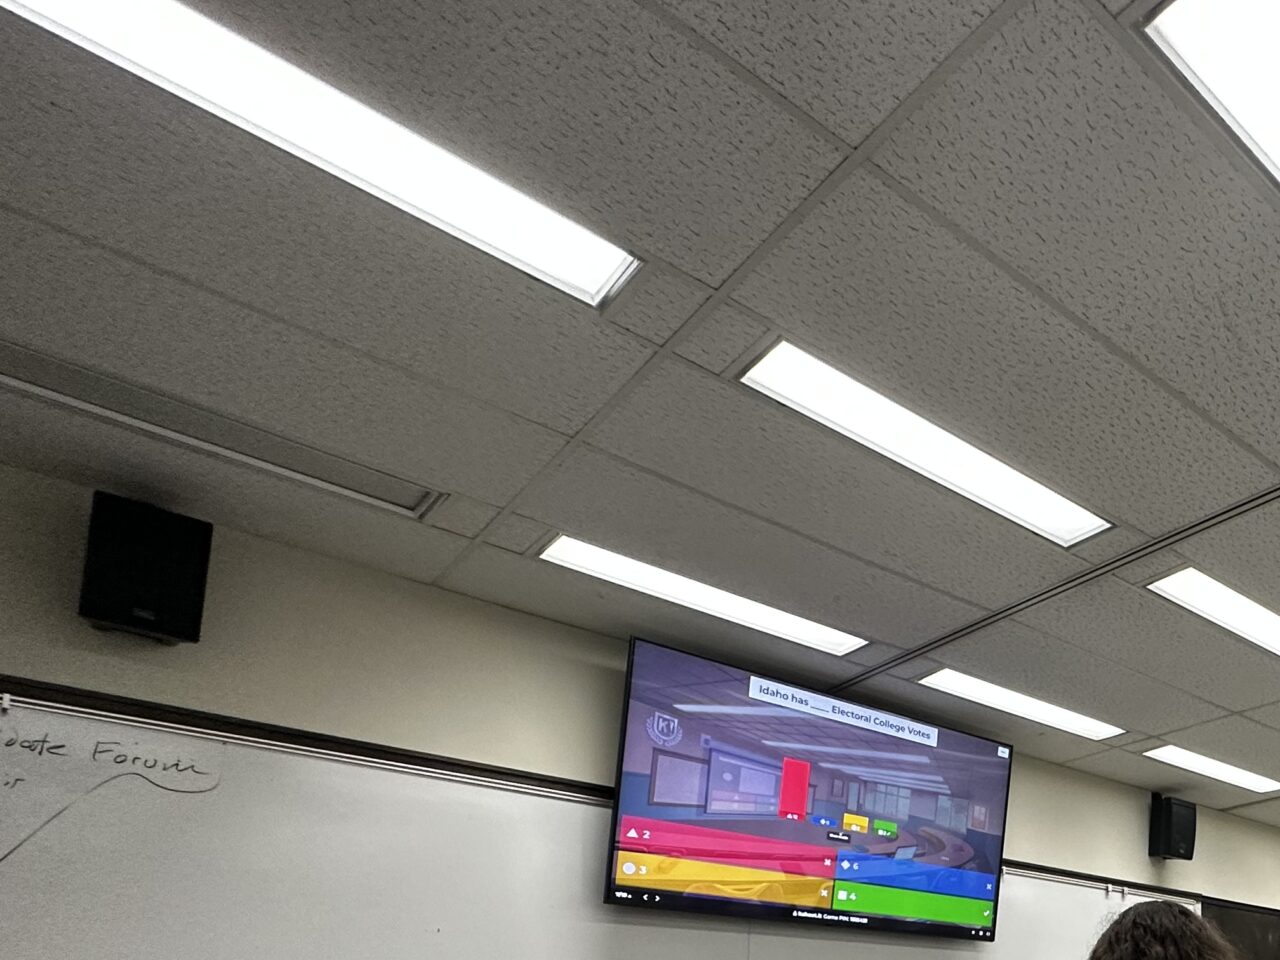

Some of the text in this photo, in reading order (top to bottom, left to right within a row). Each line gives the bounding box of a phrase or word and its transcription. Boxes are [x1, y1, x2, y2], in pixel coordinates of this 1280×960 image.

[759, 685, 789, 700] Idaho
[791, 693, 809, 706] has
[831, 705, 872, 724] Electoral
[873, 717, 906, 733] College
[907, 726, 931, 740] Votes
[92, 741, 209, 775] Forum
[642, 830, 651, 839] 2
[638, 865, 647, 875] 3
[849, 892, 857, 901] 4
